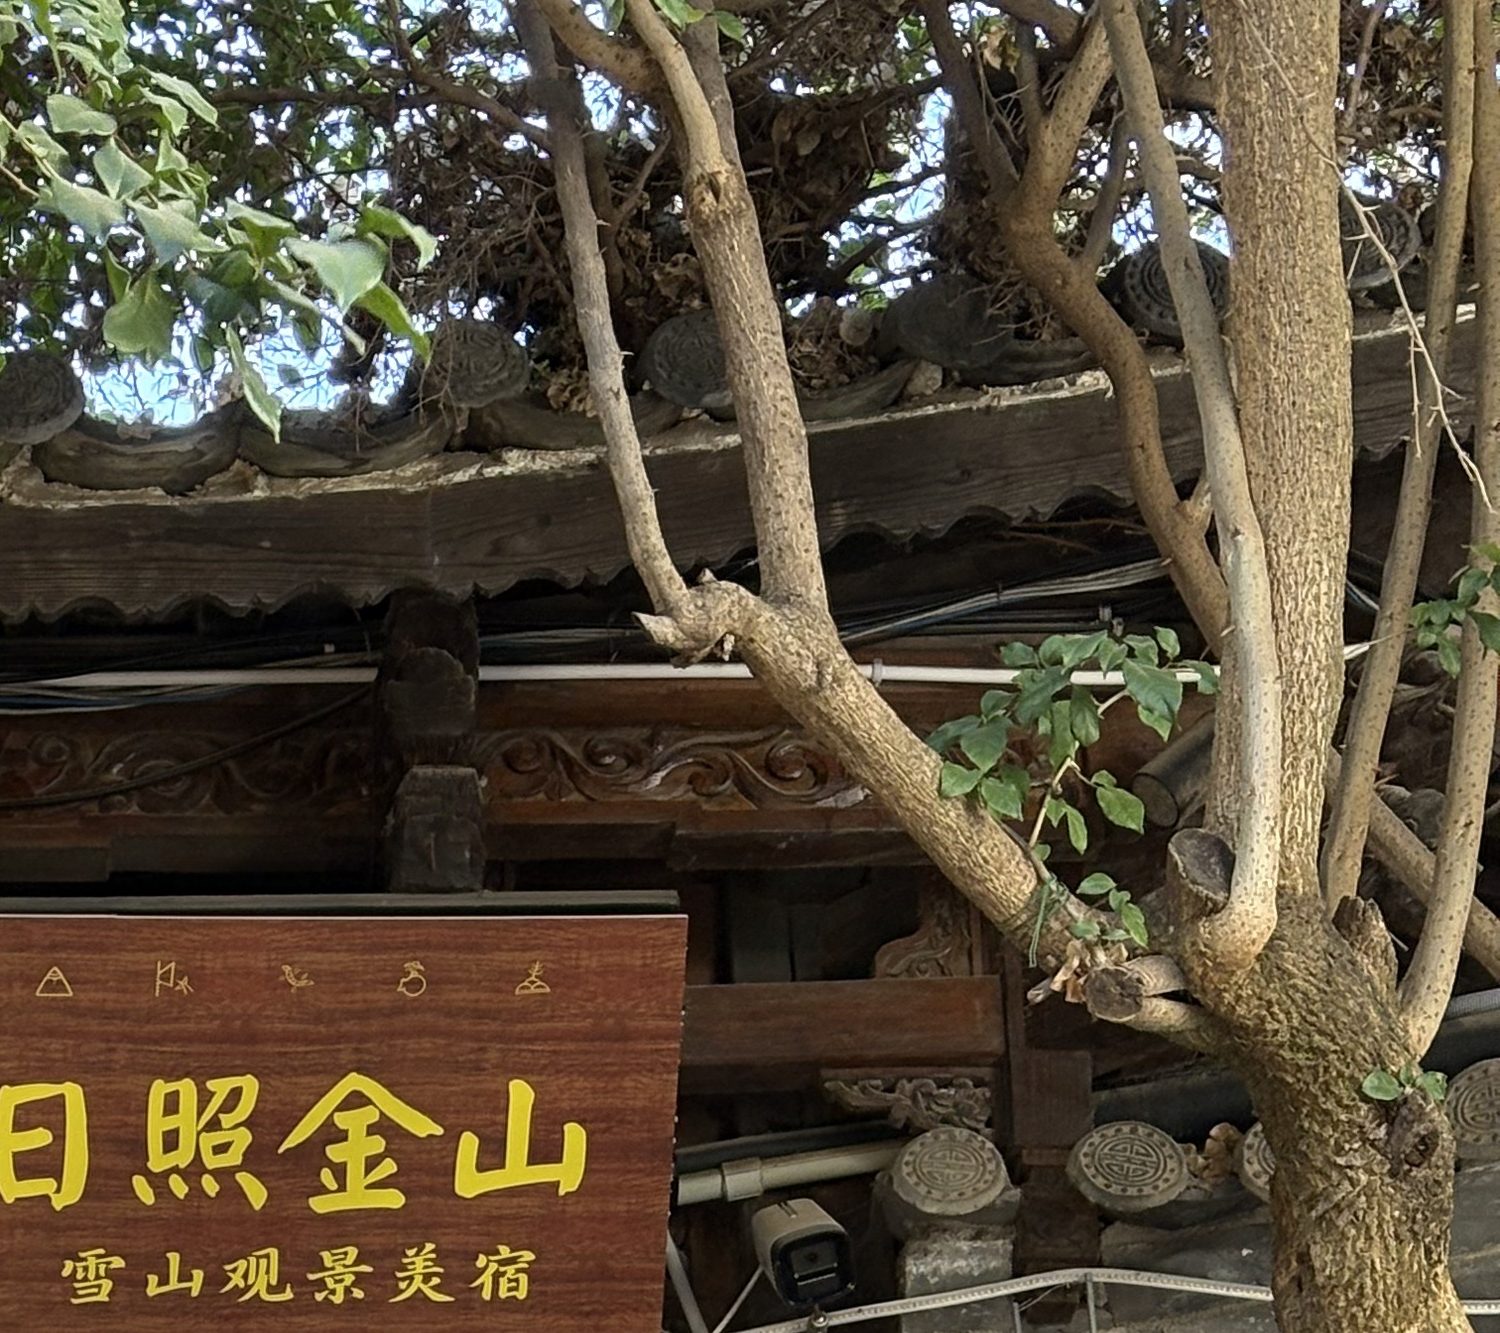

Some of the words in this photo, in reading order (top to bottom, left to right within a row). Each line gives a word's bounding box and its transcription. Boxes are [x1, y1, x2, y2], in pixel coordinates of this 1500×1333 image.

[61, 1242, 537, 1305] 雪山观景美宿
